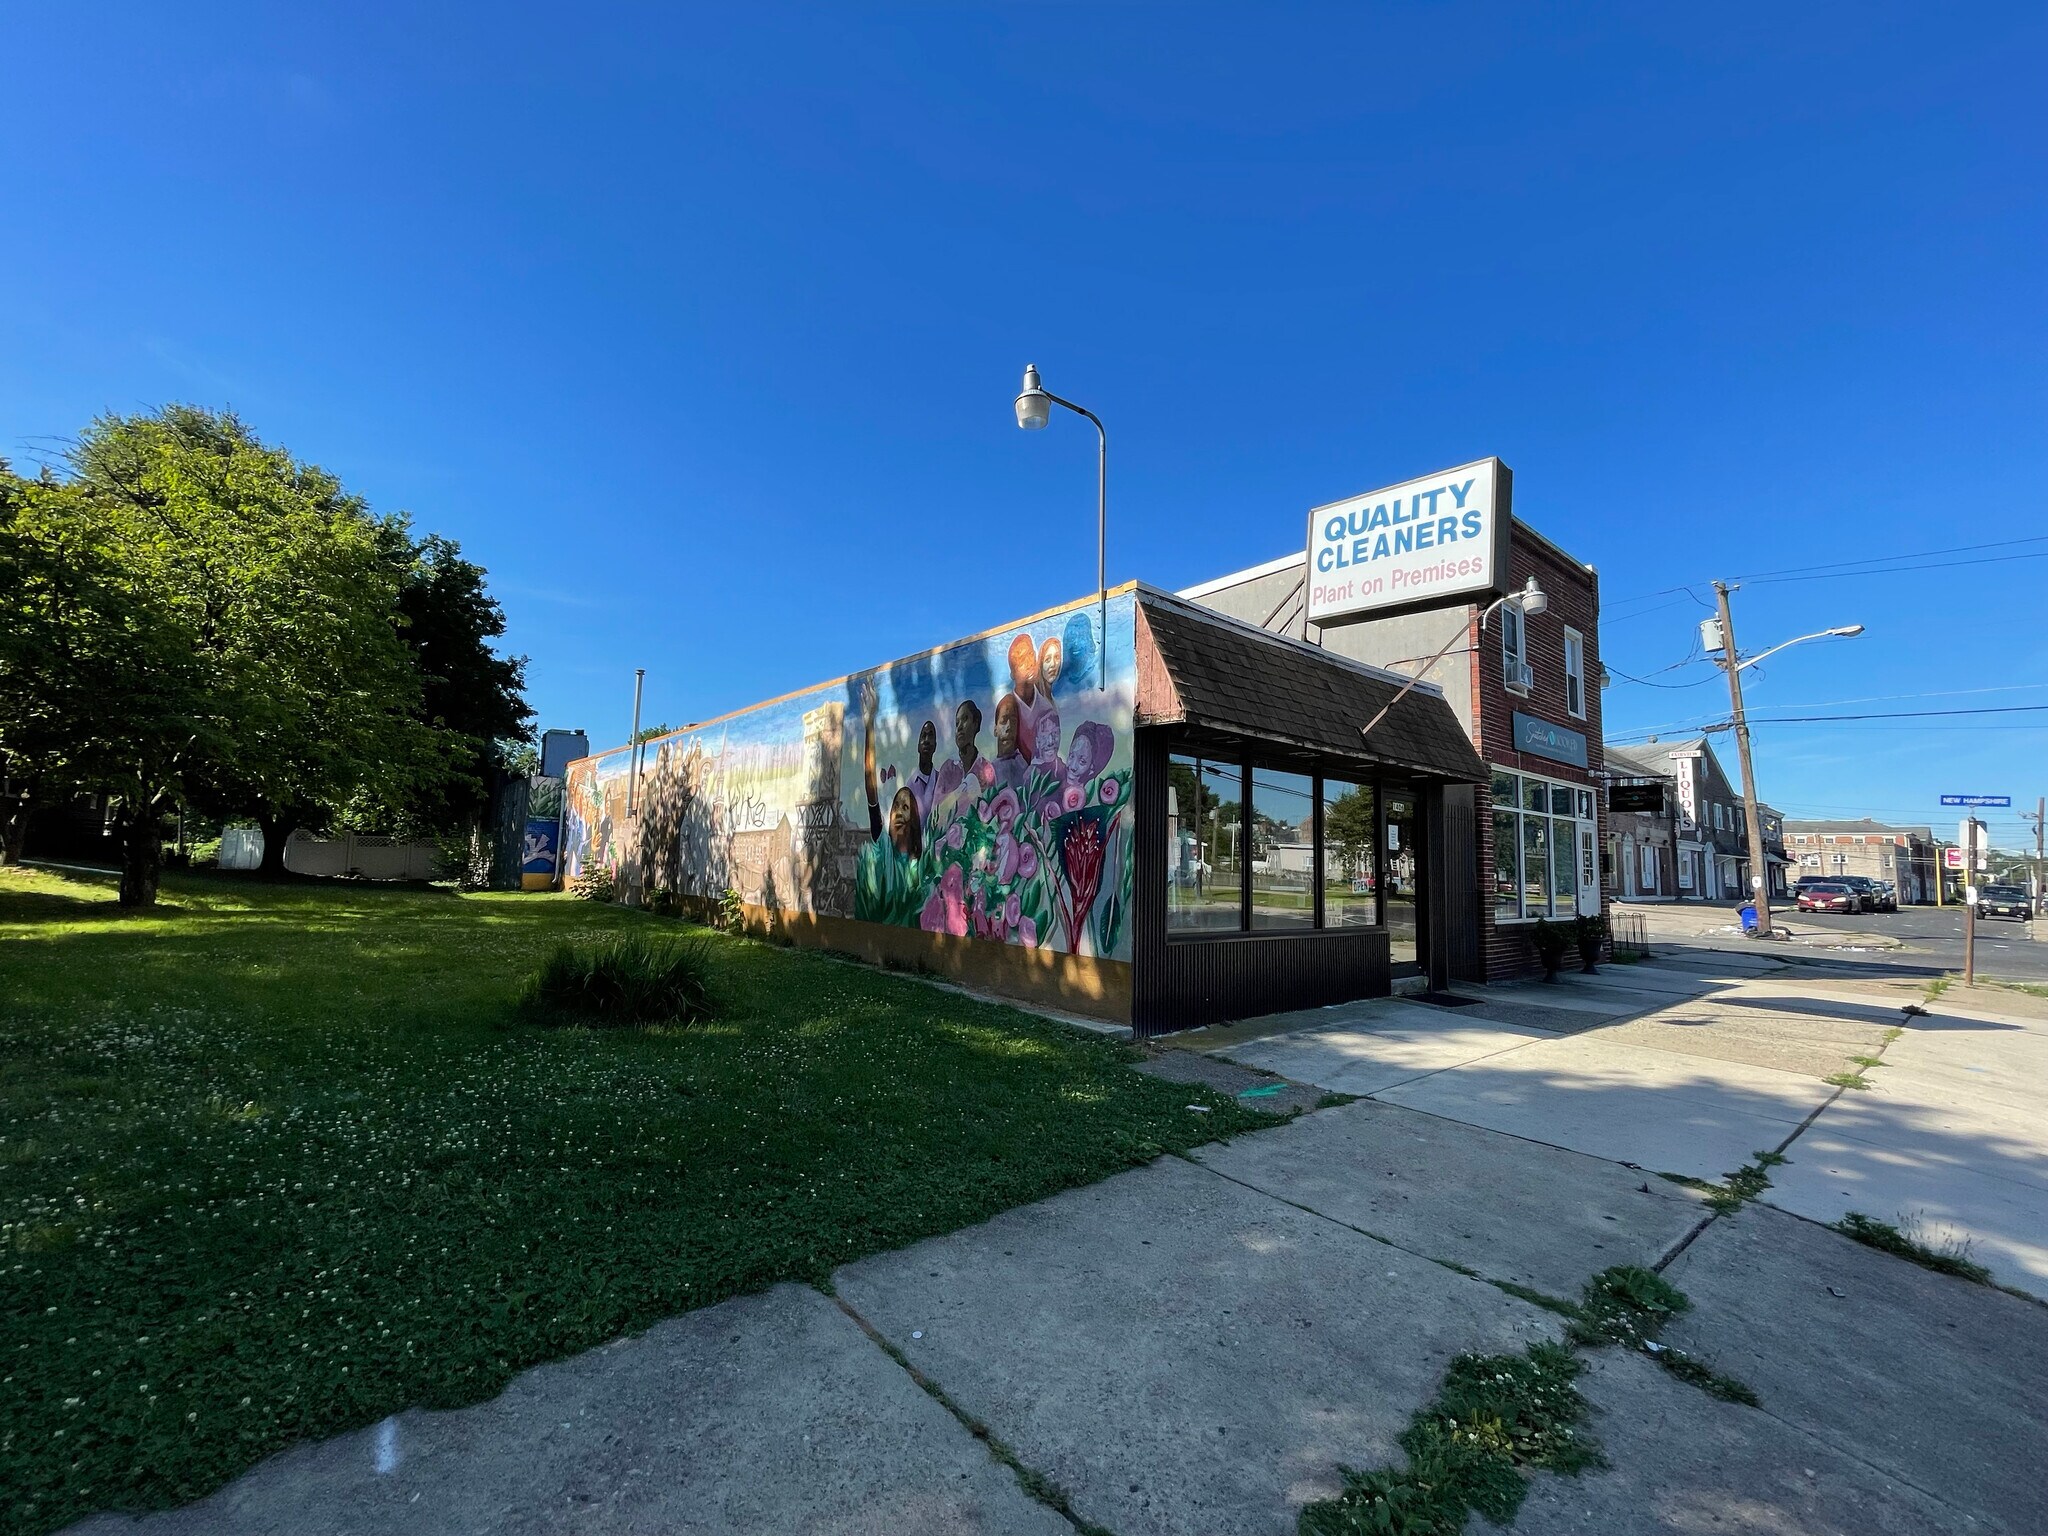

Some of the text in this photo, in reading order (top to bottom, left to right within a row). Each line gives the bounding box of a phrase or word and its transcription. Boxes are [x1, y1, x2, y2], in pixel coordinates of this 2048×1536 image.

[1317, 509, 1482, 573] CLEANERS
[1324, 478, 1476, 541] QUALITY
[1312, 556, 1482, 606] Plant on Premises
[1680, 761, 1692, 828] LIQUORS
[1353, 881, 1367, 891] OPEN
